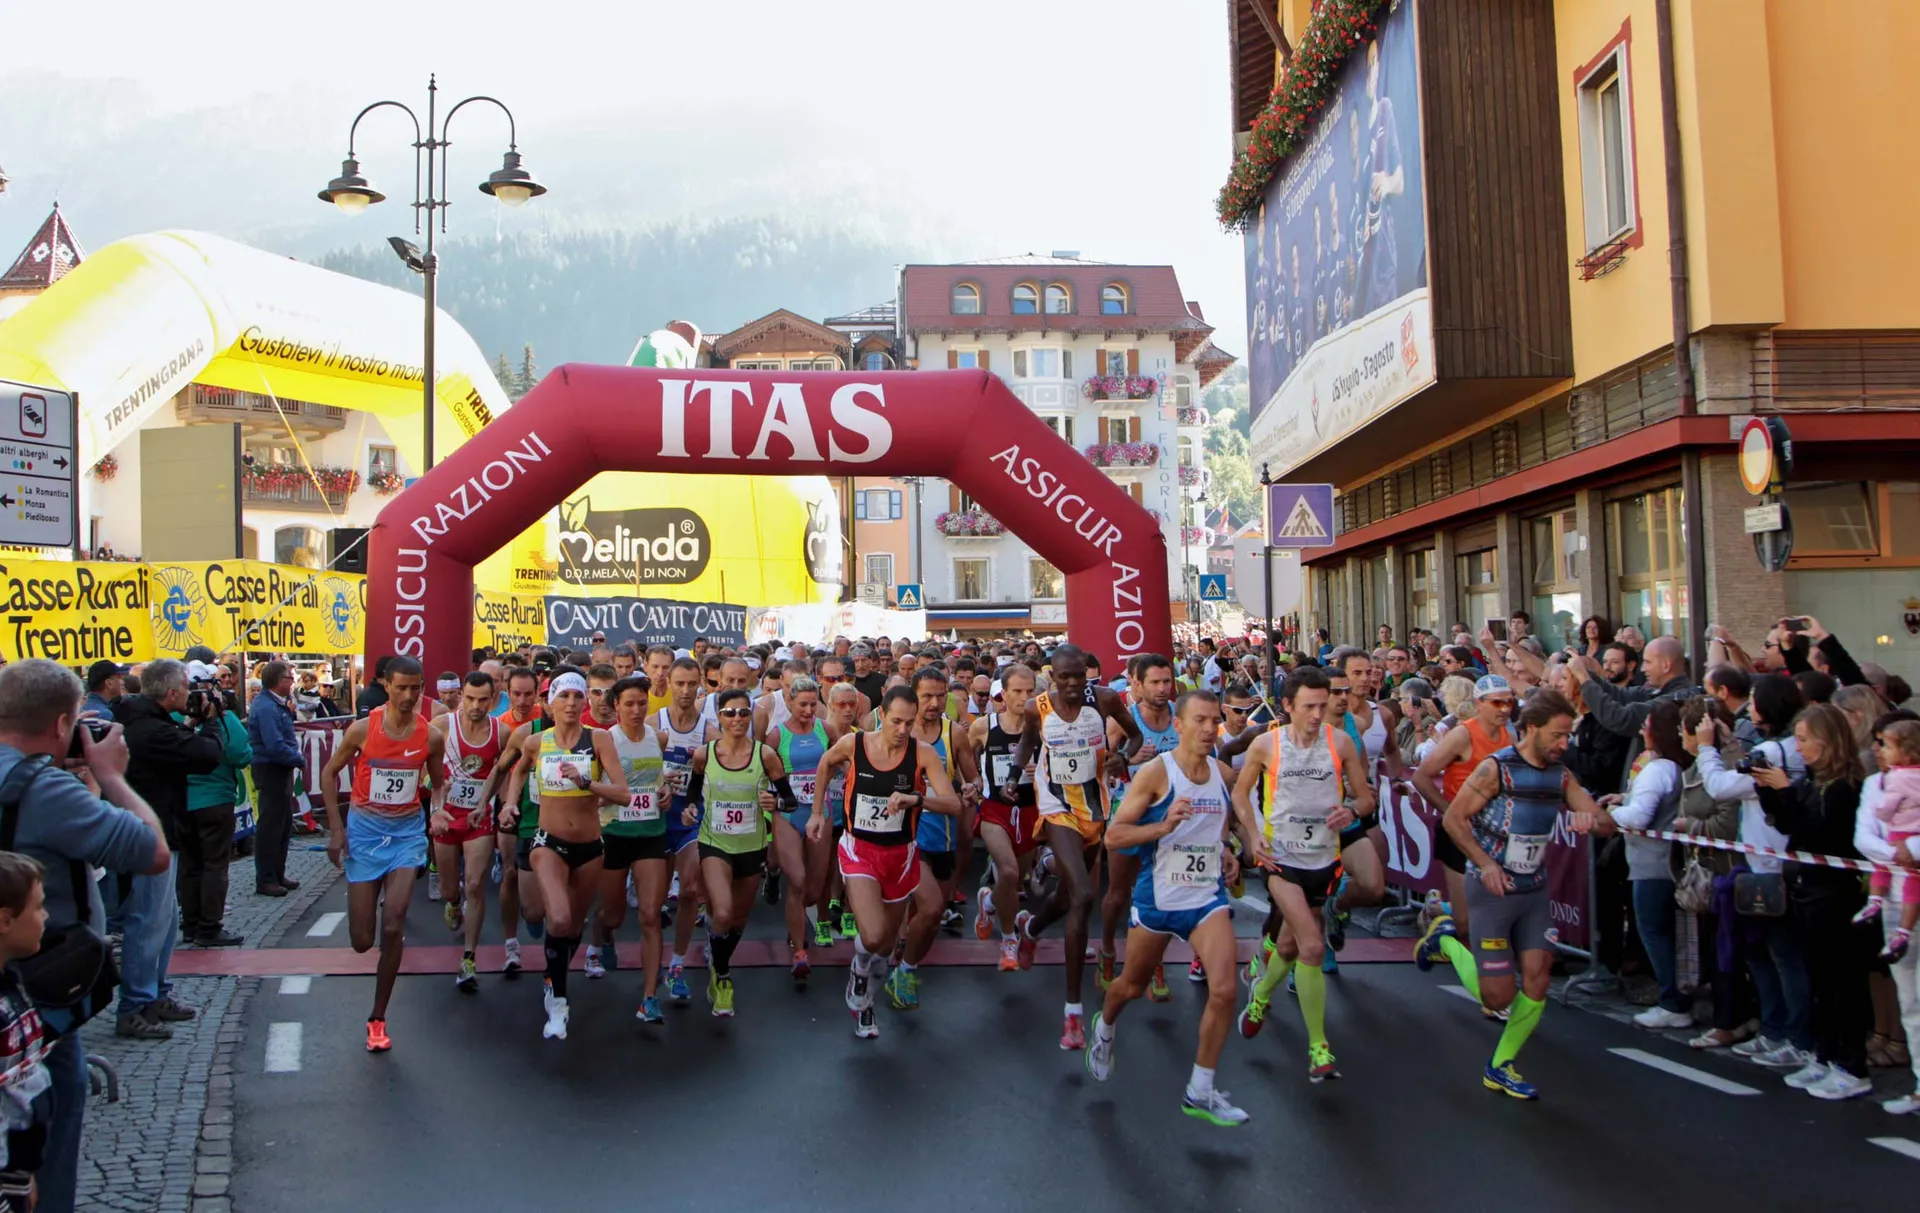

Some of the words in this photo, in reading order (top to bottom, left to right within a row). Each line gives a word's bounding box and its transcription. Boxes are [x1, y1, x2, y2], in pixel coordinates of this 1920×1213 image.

[240, 325, 325, 365] Gustatevi
[324, 340, 341, 367] il
[338, 353, 389, 376] nostro
[1369, 340, 1395, 380] agosto
[104, 337, 205, 431] TRENTINGRANA
[1156, 358, 1168, 422] HOTEL
[465, 387, 497, 427] TREN
[657, 378, 894, 464] ITAS
[0, 446, 16, 455] altri
[19, 449, 49, 461] alberghi
[1158, 433, 1171, 523] FALORIA
[25, 486, 33, 495] La
[36, 487, 69, 498] Romantica
[25, 499, 46, 509] Monza
[25, 512, 60, 523] Piedibosco
[592, 568, 619, 578] MELA
[644, 567, 655, 579] DI
[657, 567, 687, 579] NON
[76, 567, 149, 611] Rurali
[205, 563, 266, 606] Casse
[269, 568, 319, 609] Rurali
[394, 547, 427, 664] SSICU
[474, 590, 510, 624] Casse
[511, 596, 544, 626] Rurali
[1111, 560, 1150, 661] AZIO
[550, 600, 623, 635] CAVIT
[628, 601, 691, 633] CAVIT
[693, 604, 746, 634] CAVIT
[226, 607, 305, 649] Trentine
[8, 613, 134, 661] Trentine
[646, 634, 676, 644] TRENTO
[708, 635, 735, 645] TRENTO
[1069, 758, 1078, 773] 9
[1282, 768, 1323, 778] saucony
[1056, 773, 1073, 781] ITAS
[385, 778, 405, 793] 29
[460, 785, 475, 799] 39
[803, 782, 816, 795] 49
[374, 792, 393, 801] ITAS
[633, 795, 650, 809] 48
[623, 810, 641, 818] ITAS
[726, 810, 743, 824] 50
[870, 805, 890, 821] 24
[715, 823, 733, 832] ITAS
[859, 818, 877, 828] ITAS
[1304, 825, 1314, 841] 5
[1286, 840, 1306, 849] ITAS
[1185, 854, 1206, 873] 26
[1171, 872, 1193, 882] ITAS
[1549, 899, 1580, 926] ONDS
